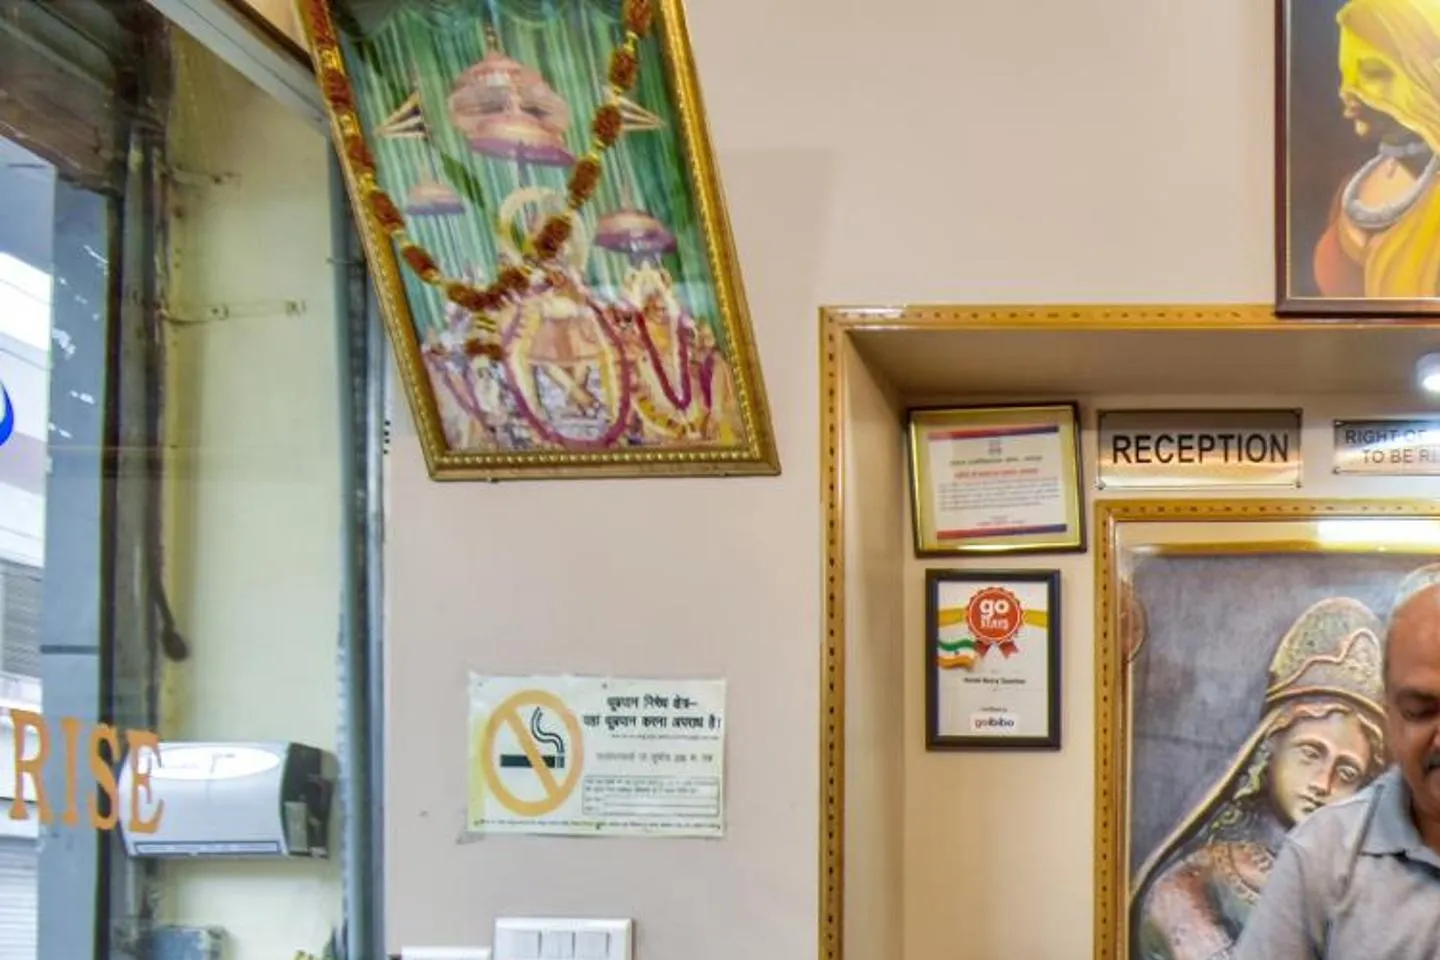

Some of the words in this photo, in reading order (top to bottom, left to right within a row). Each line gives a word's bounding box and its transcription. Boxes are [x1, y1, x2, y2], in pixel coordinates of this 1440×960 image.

[1345, 429, 1395, 444] RIGHT
[1112, 433, 1289, 464] RECEPTION
[1362, 450, 1384, 464] TO
[1390, 449, 1413, 464] BE
[980, 599, 1010, 617] go
[641, 715, 668, 728] करना
